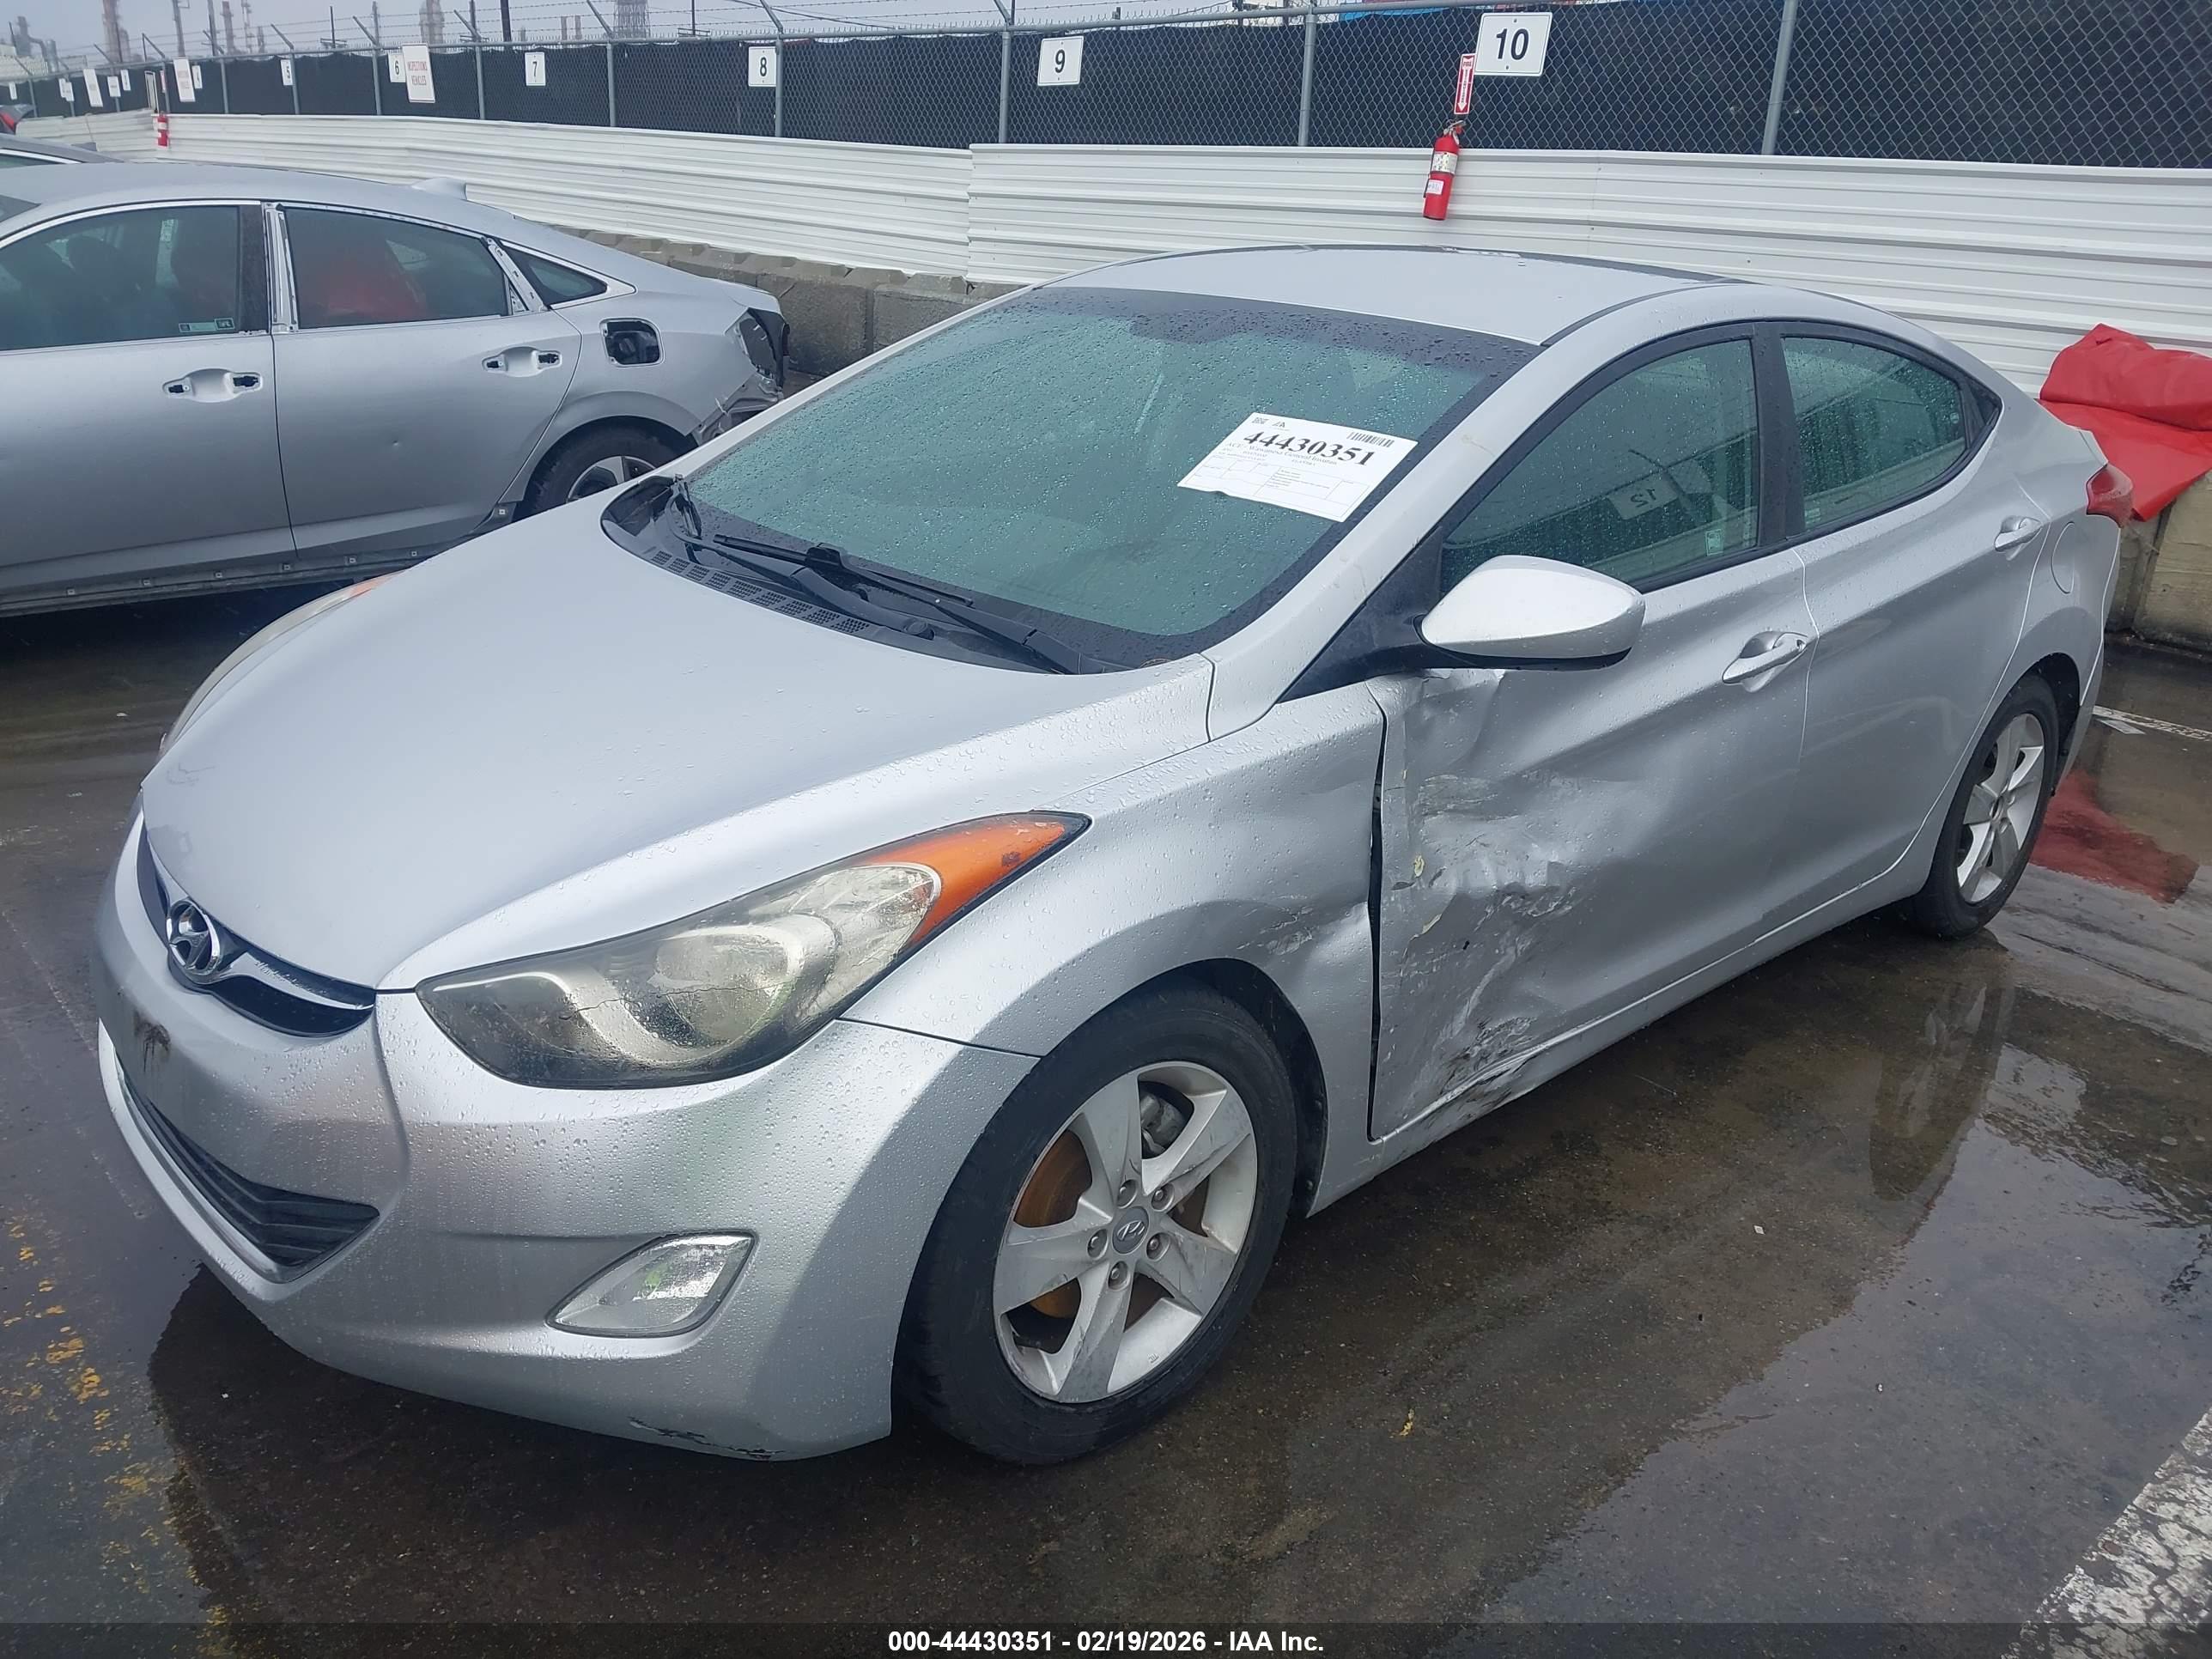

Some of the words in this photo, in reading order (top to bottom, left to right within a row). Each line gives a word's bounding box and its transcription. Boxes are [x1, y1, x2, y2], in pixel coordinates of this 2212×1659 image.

[1496, 28, 1529, 61] 10
[394, 60, 400, 76] 6
[532, 61, 538, 77] 7
[759, 56, 768, 77] 8
[1054, 49, 1066, 74] 9
[286, 66, 291, 79] 5
[1243, 431, 1376, 465] 44430351
